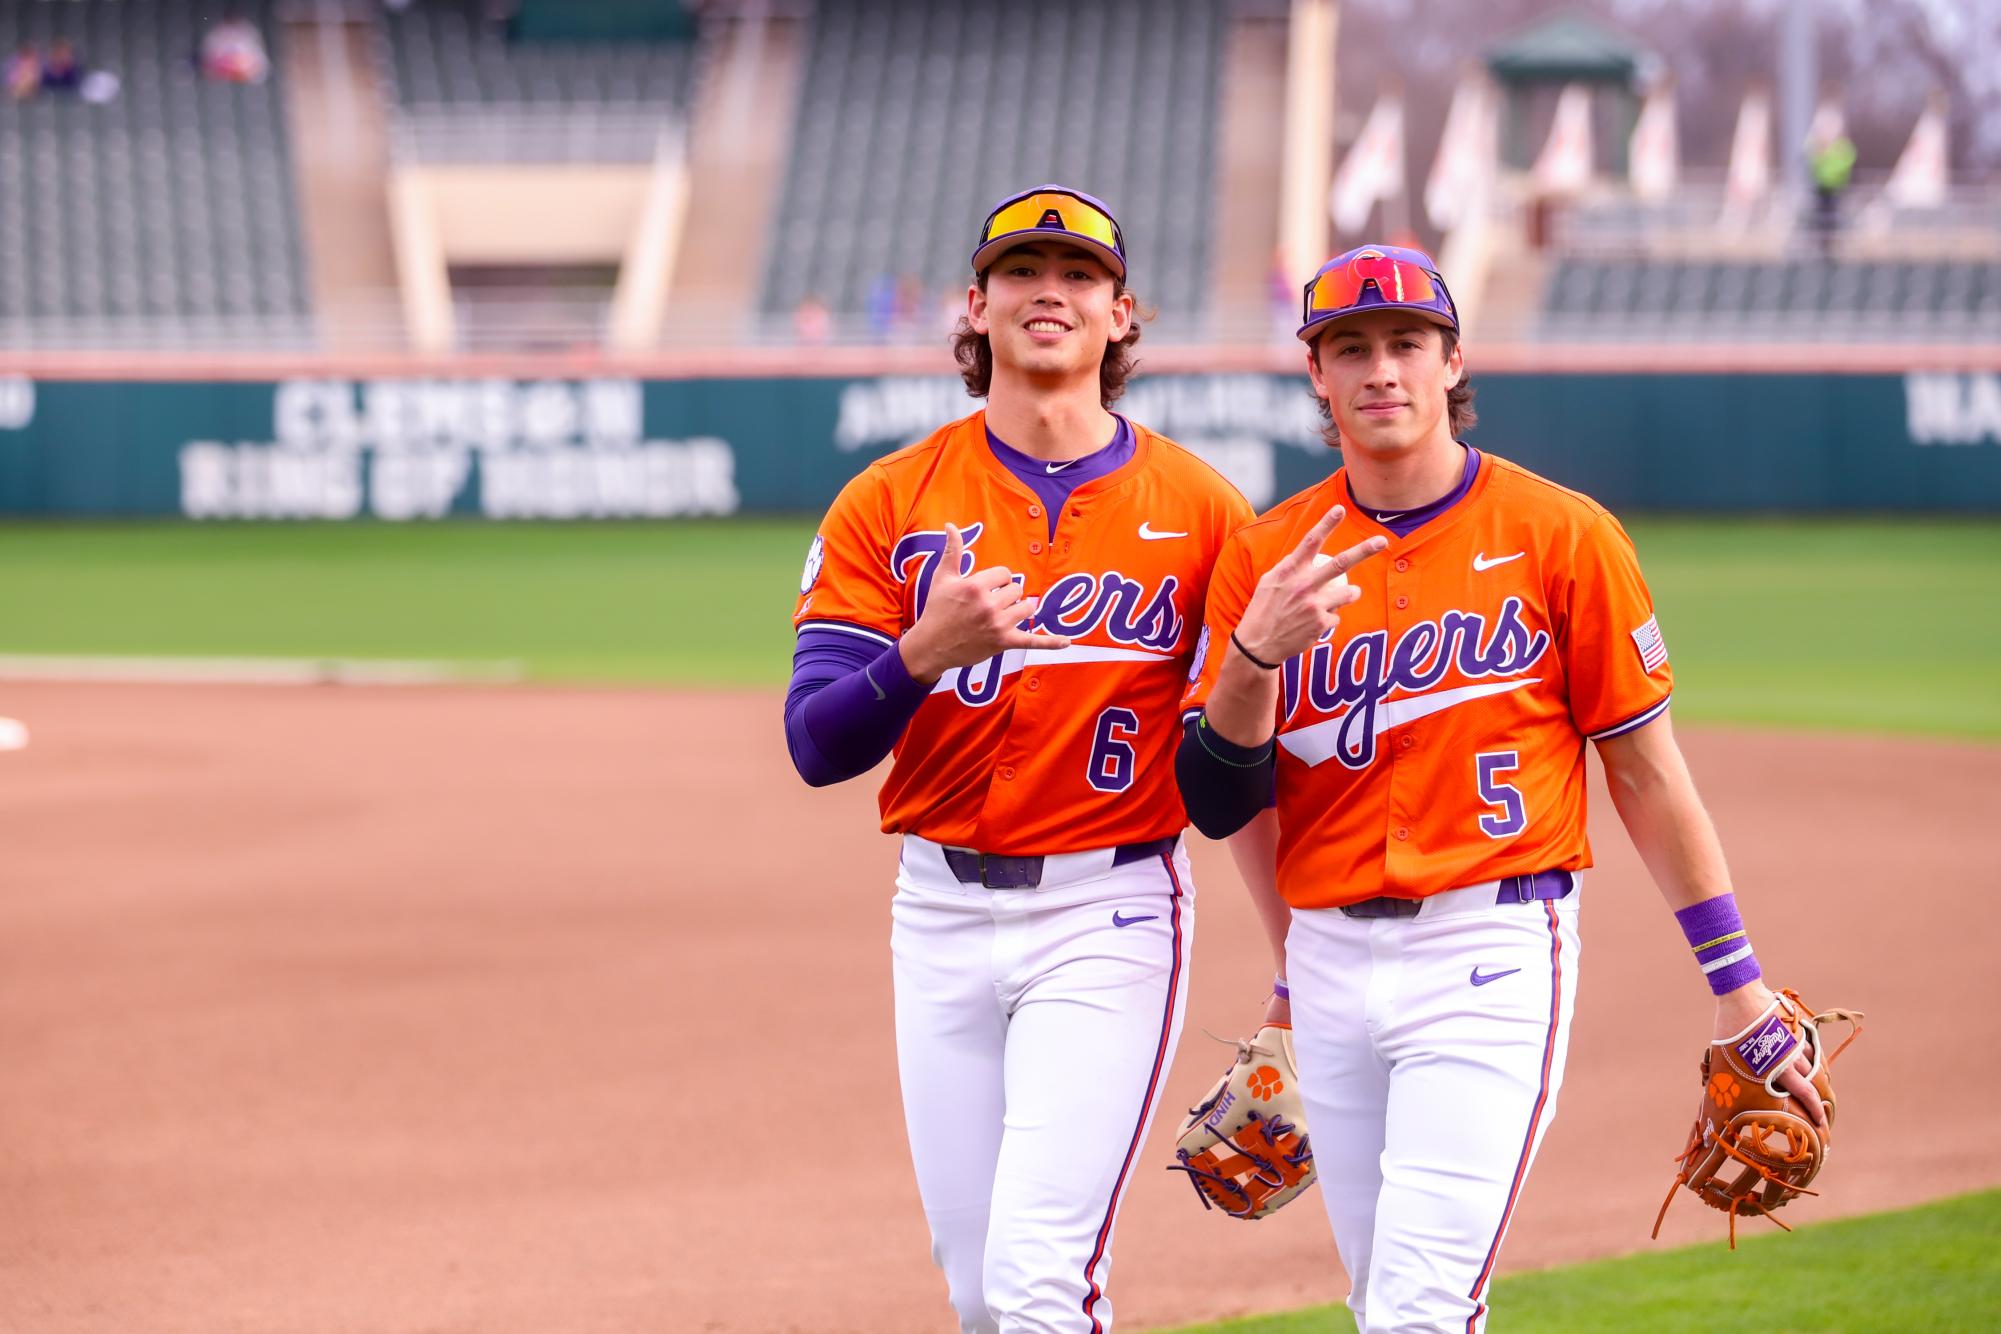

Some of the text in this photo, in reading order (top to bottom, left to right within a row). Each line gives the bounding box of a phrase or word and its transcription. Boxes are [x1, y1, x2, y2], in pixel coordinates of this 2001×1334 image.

[1087, 706, 1139, 792] 6
[1476, 751, 1527, 838] 5
[1752, 1026, 1785, 1065] Rawlings
